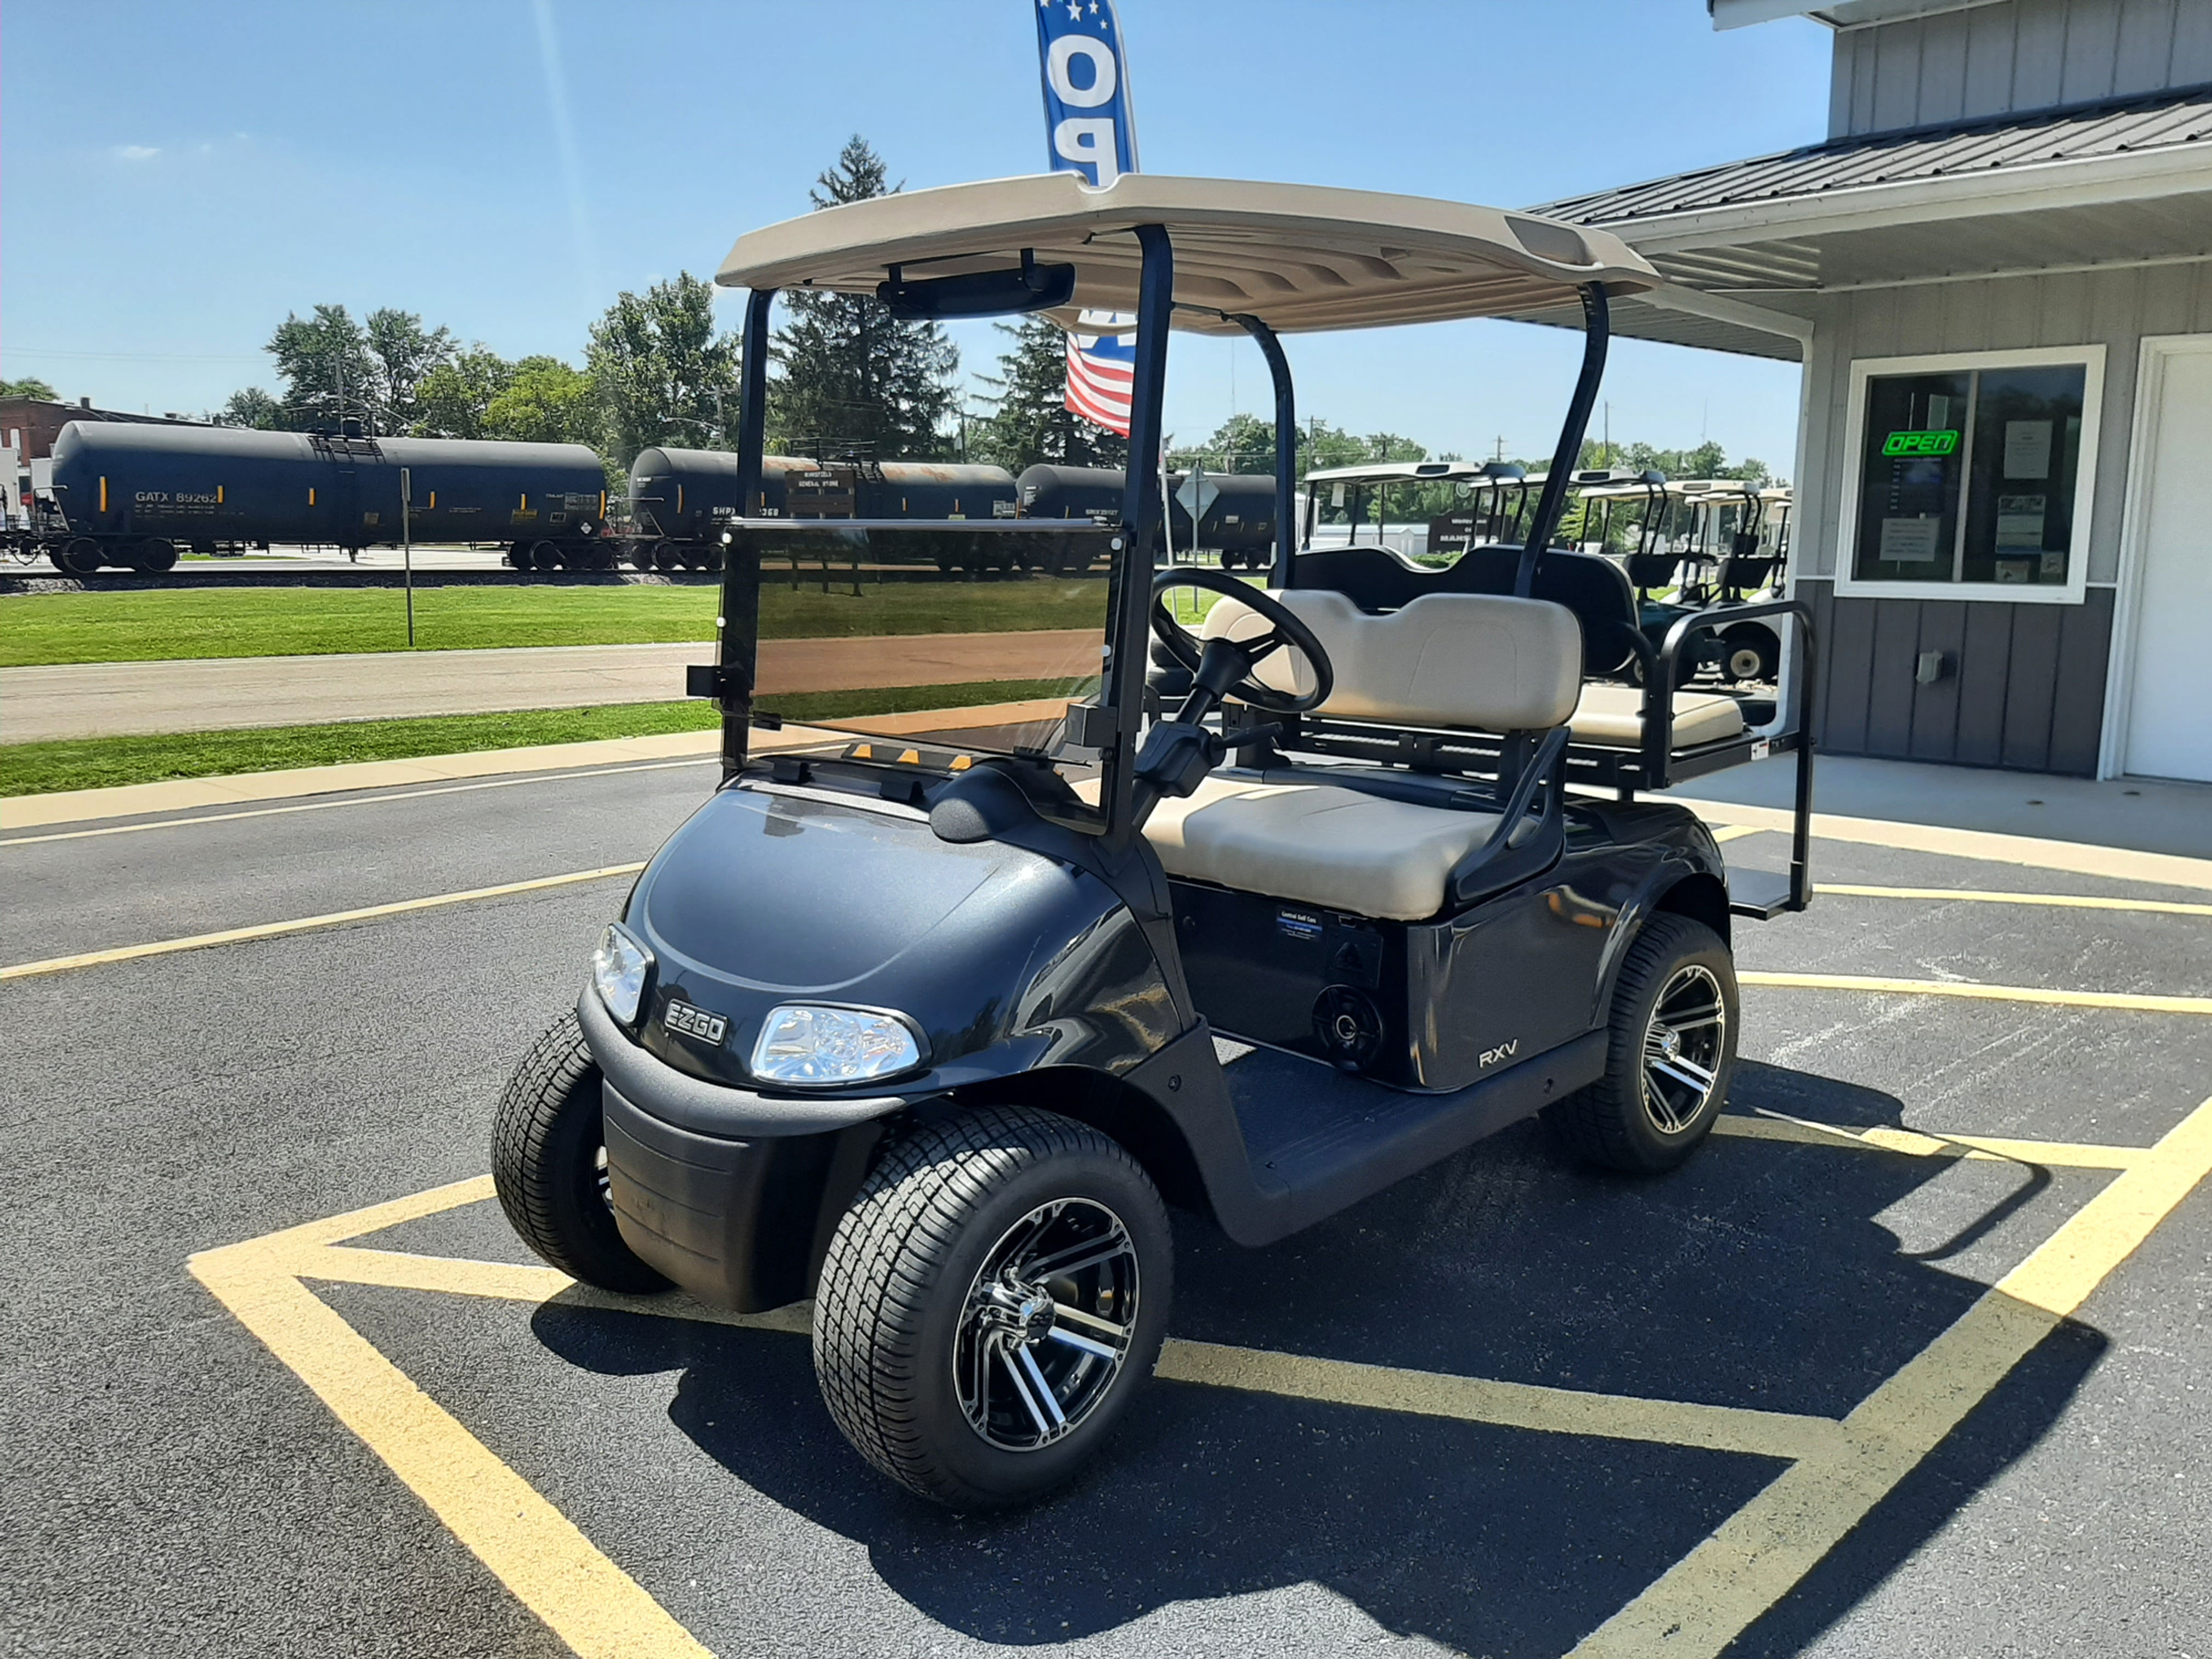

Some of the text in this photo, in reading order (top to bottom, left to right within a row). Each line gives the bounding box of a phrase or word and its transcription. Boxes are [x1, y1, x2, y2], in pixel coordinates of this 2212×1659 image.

[1887, 435, 1951, 451] OPEN
[136, 492, 217, 503] GATX 89262
[1479, 1039, 1517, 1068] RXV
